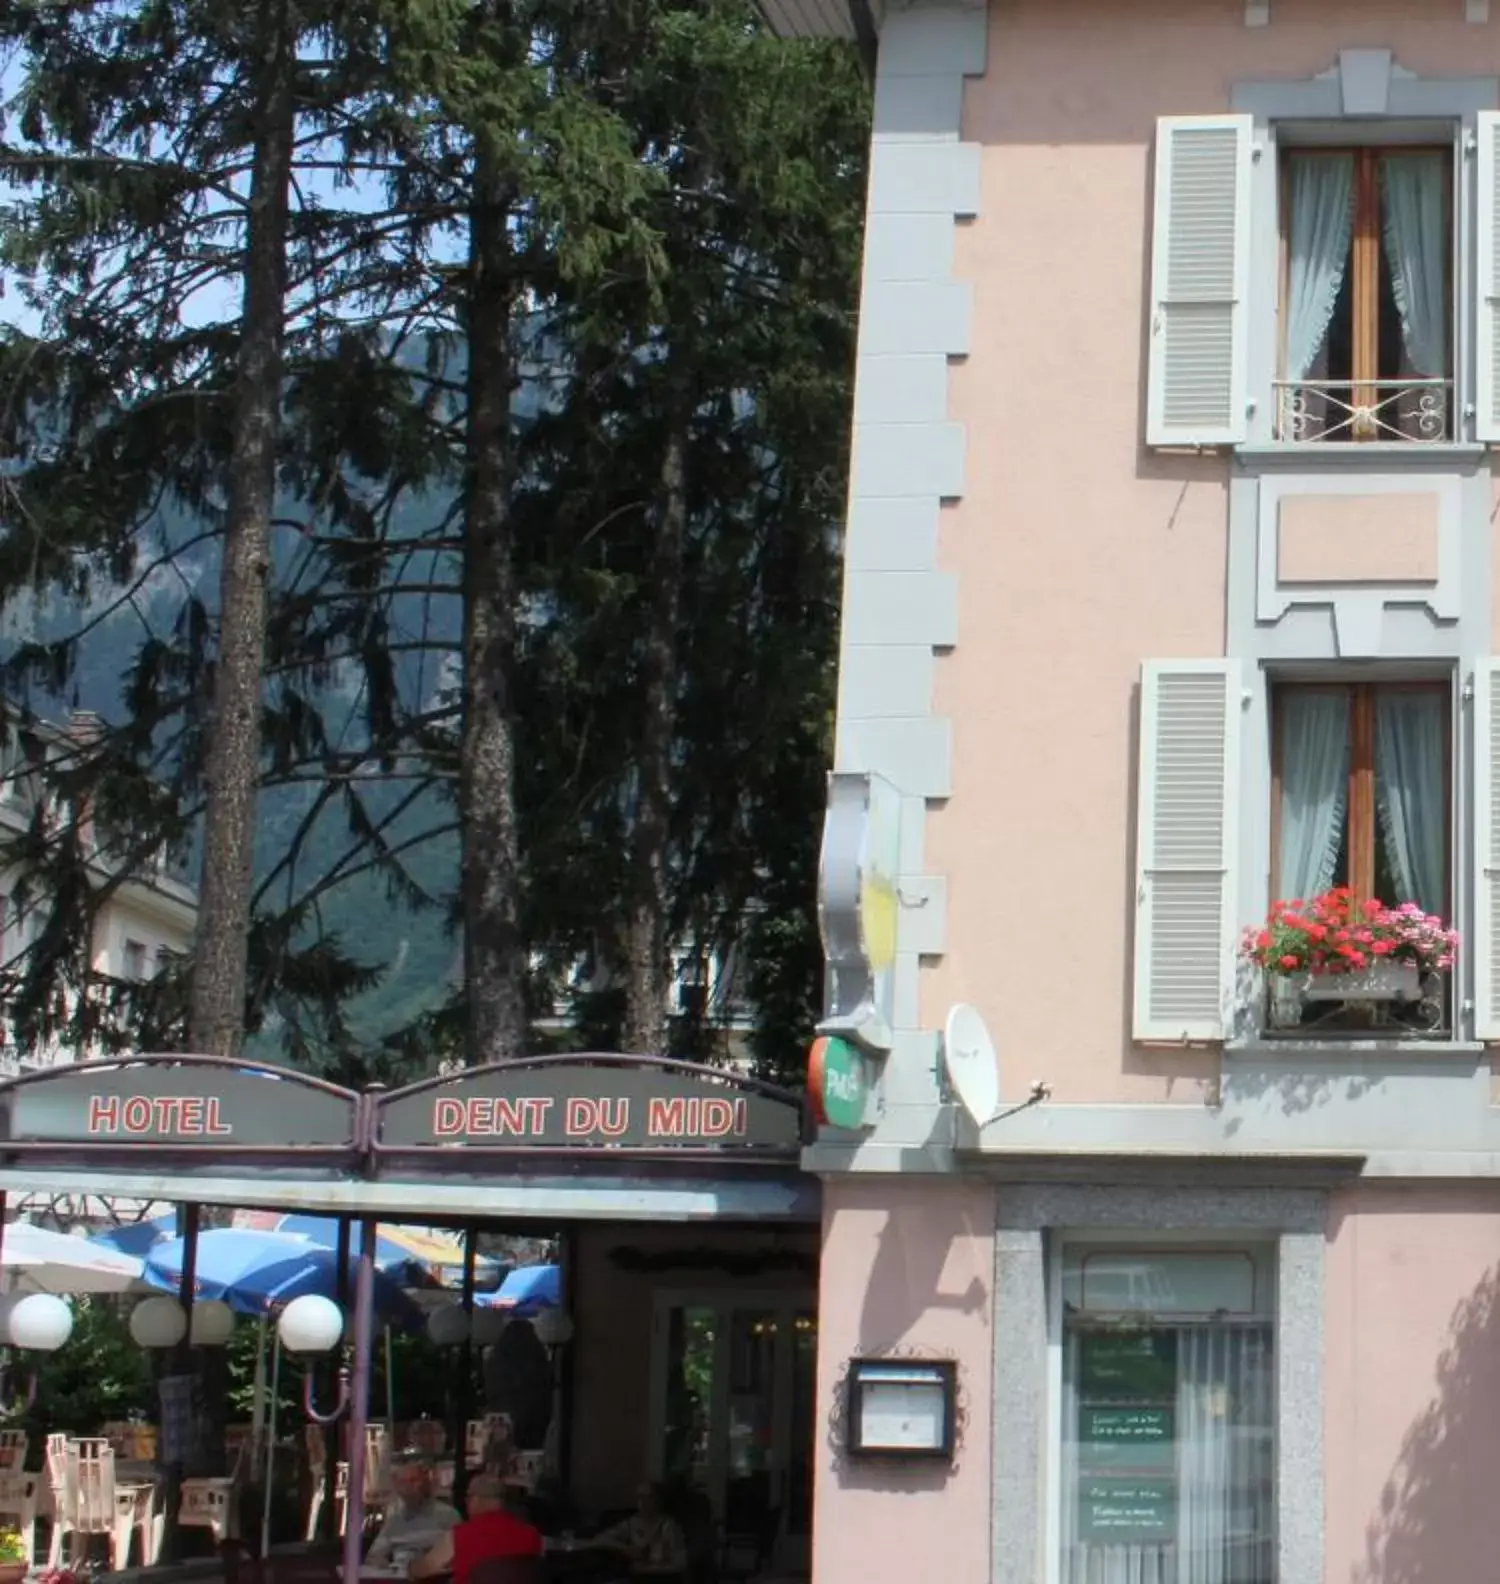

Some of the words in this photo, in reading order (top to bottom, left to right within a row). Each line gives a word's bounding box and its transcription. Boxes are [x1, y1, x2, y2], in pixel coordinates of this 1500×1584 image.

[88, 1095, 232, 1135] HOTEL
[433, 1097, 553, 1136] DENT
[564, 1097, 630, 1136] DU
[646, 1097, 747, 1137] MIDI
